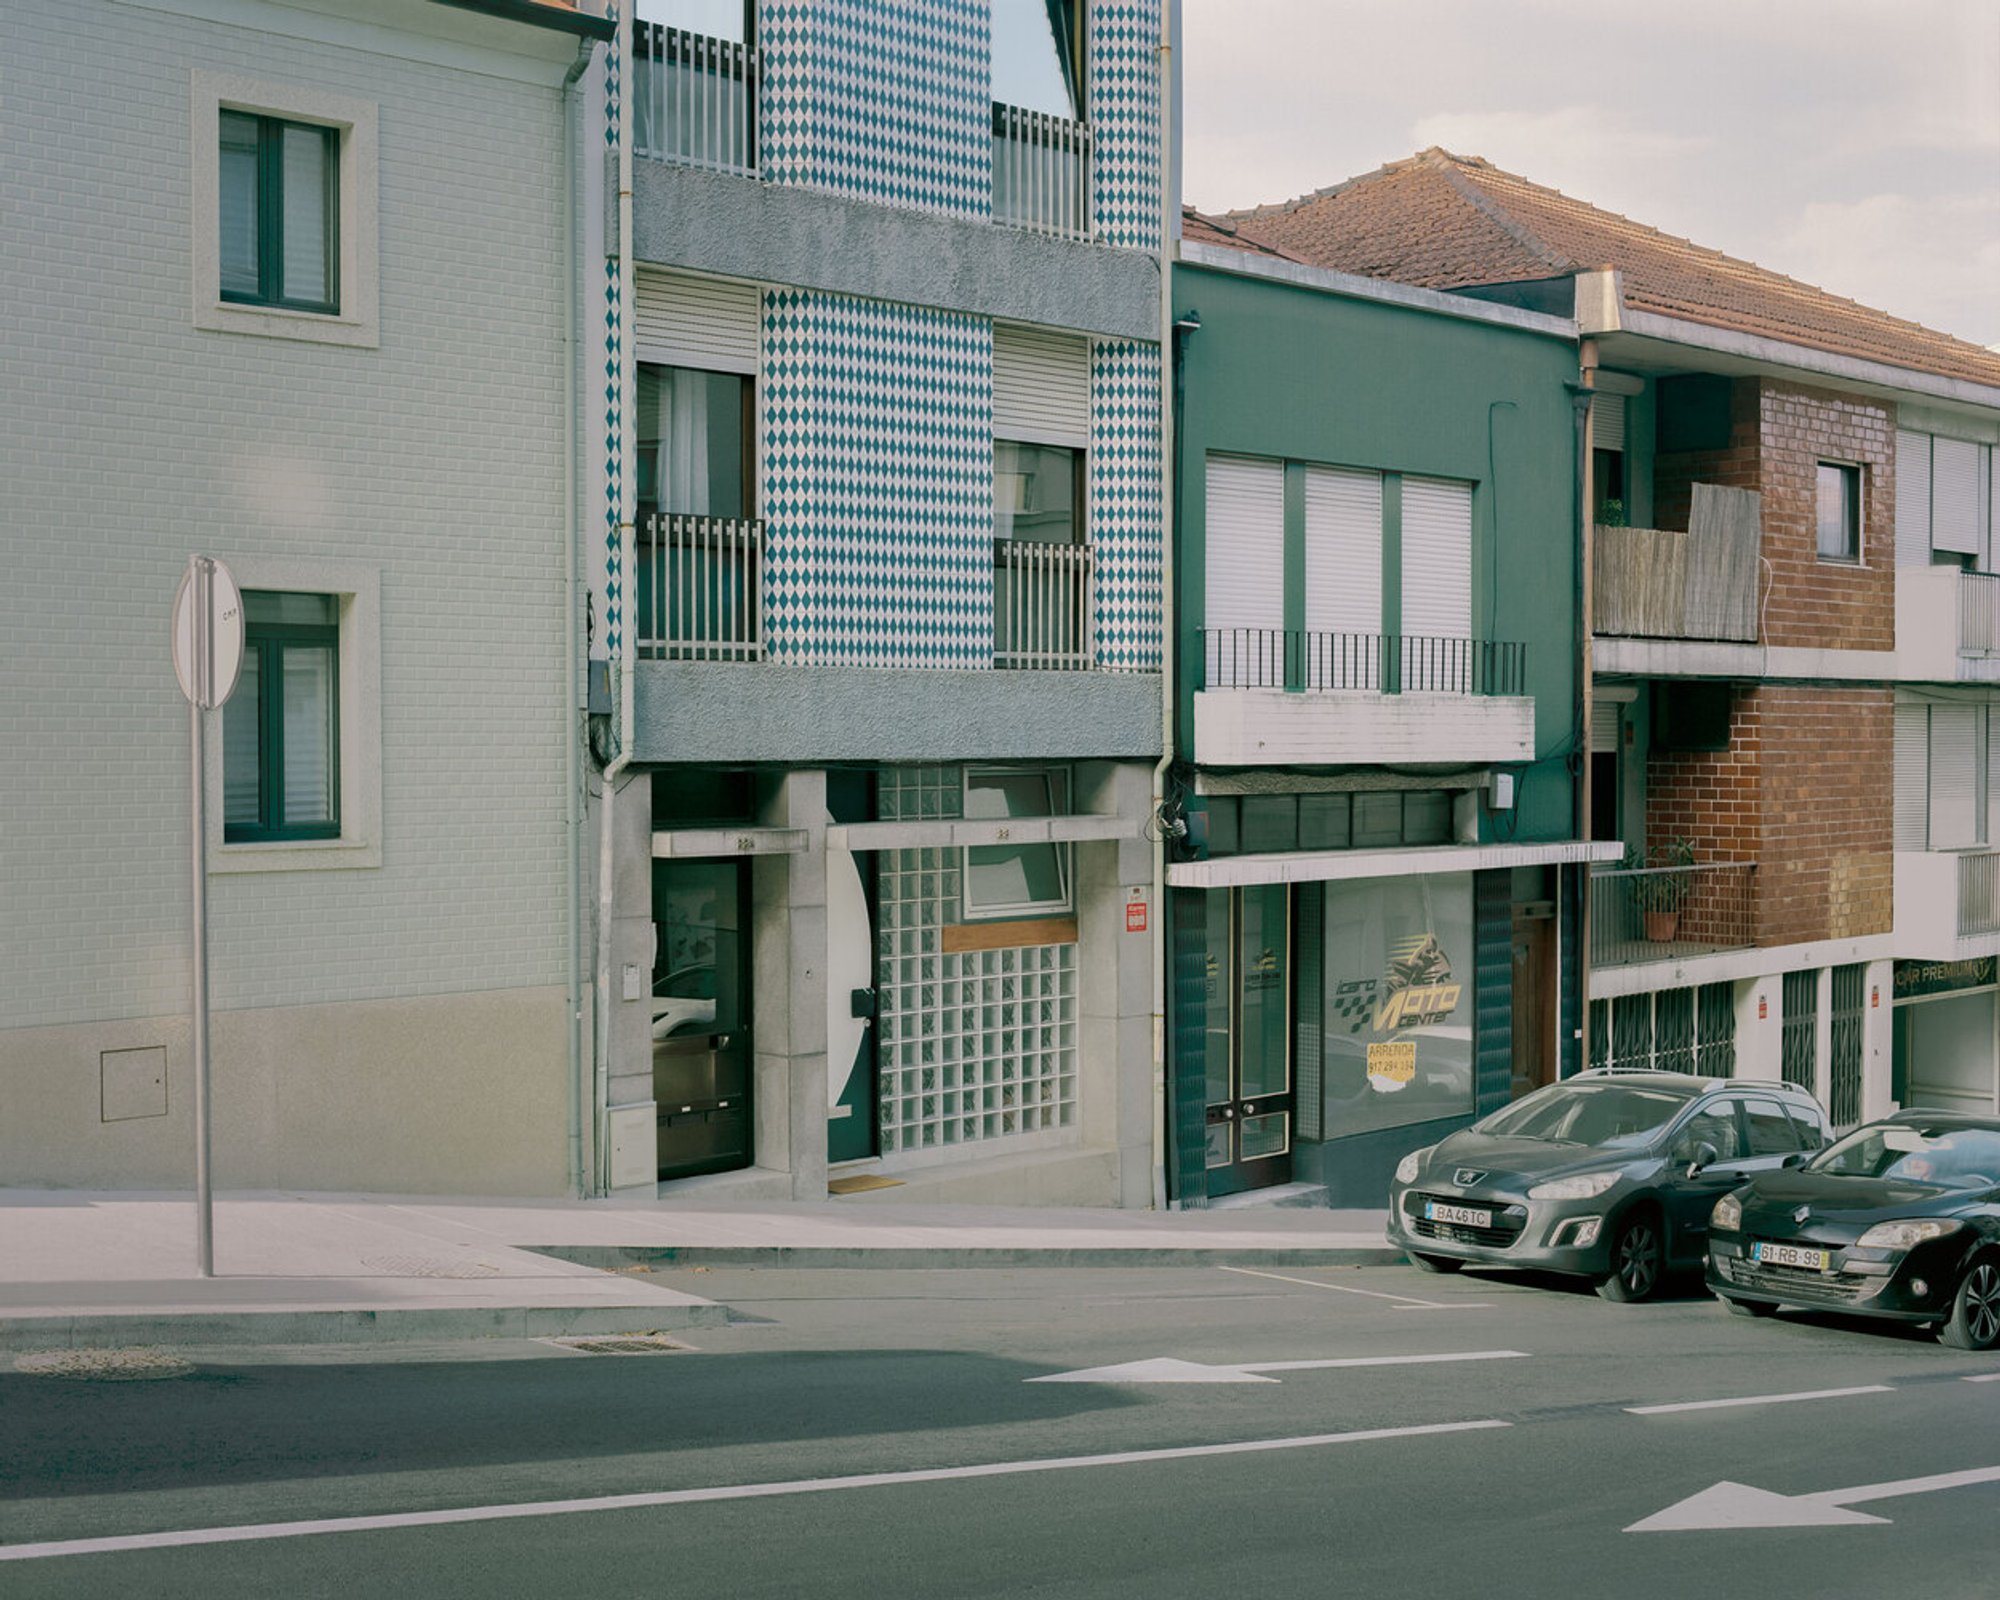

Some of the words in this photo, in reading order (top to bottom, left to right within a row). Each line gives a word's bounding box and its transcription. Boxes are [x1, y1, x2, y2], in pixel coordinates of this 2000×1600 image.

[1922, 961, 1972, 981] PREMIUM
[1373, 985, 1461, 1030] MOTO
[1369, 1044, 1414, 1058] ARRENDA
